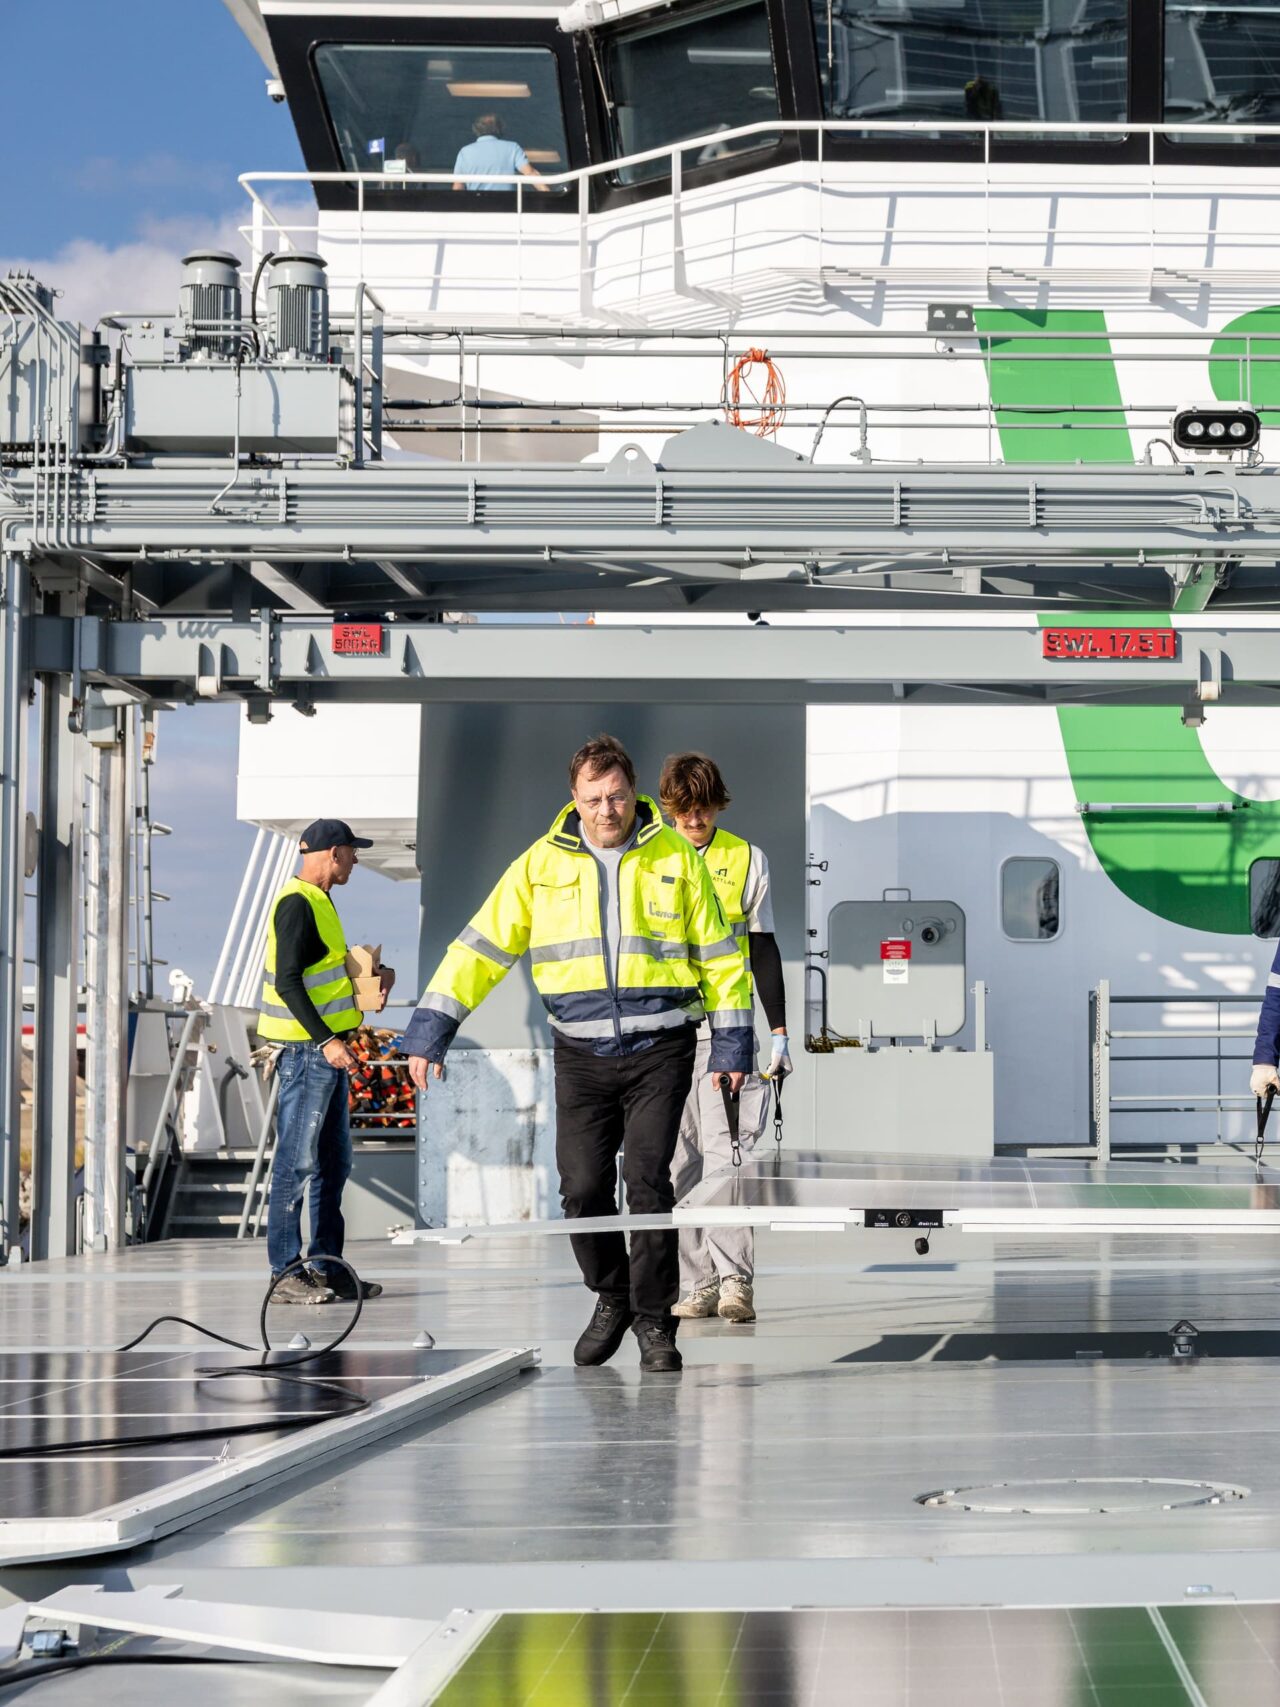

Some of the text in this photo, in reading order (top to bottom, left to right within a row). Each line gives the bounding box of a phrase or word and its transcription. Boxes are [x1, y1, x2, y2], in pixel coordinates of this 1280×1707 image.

[342, 627, 371, 637] SWL
[1046, 633, 1103, 652] SWL
[712, 877, 736, 887] ATTLAB
